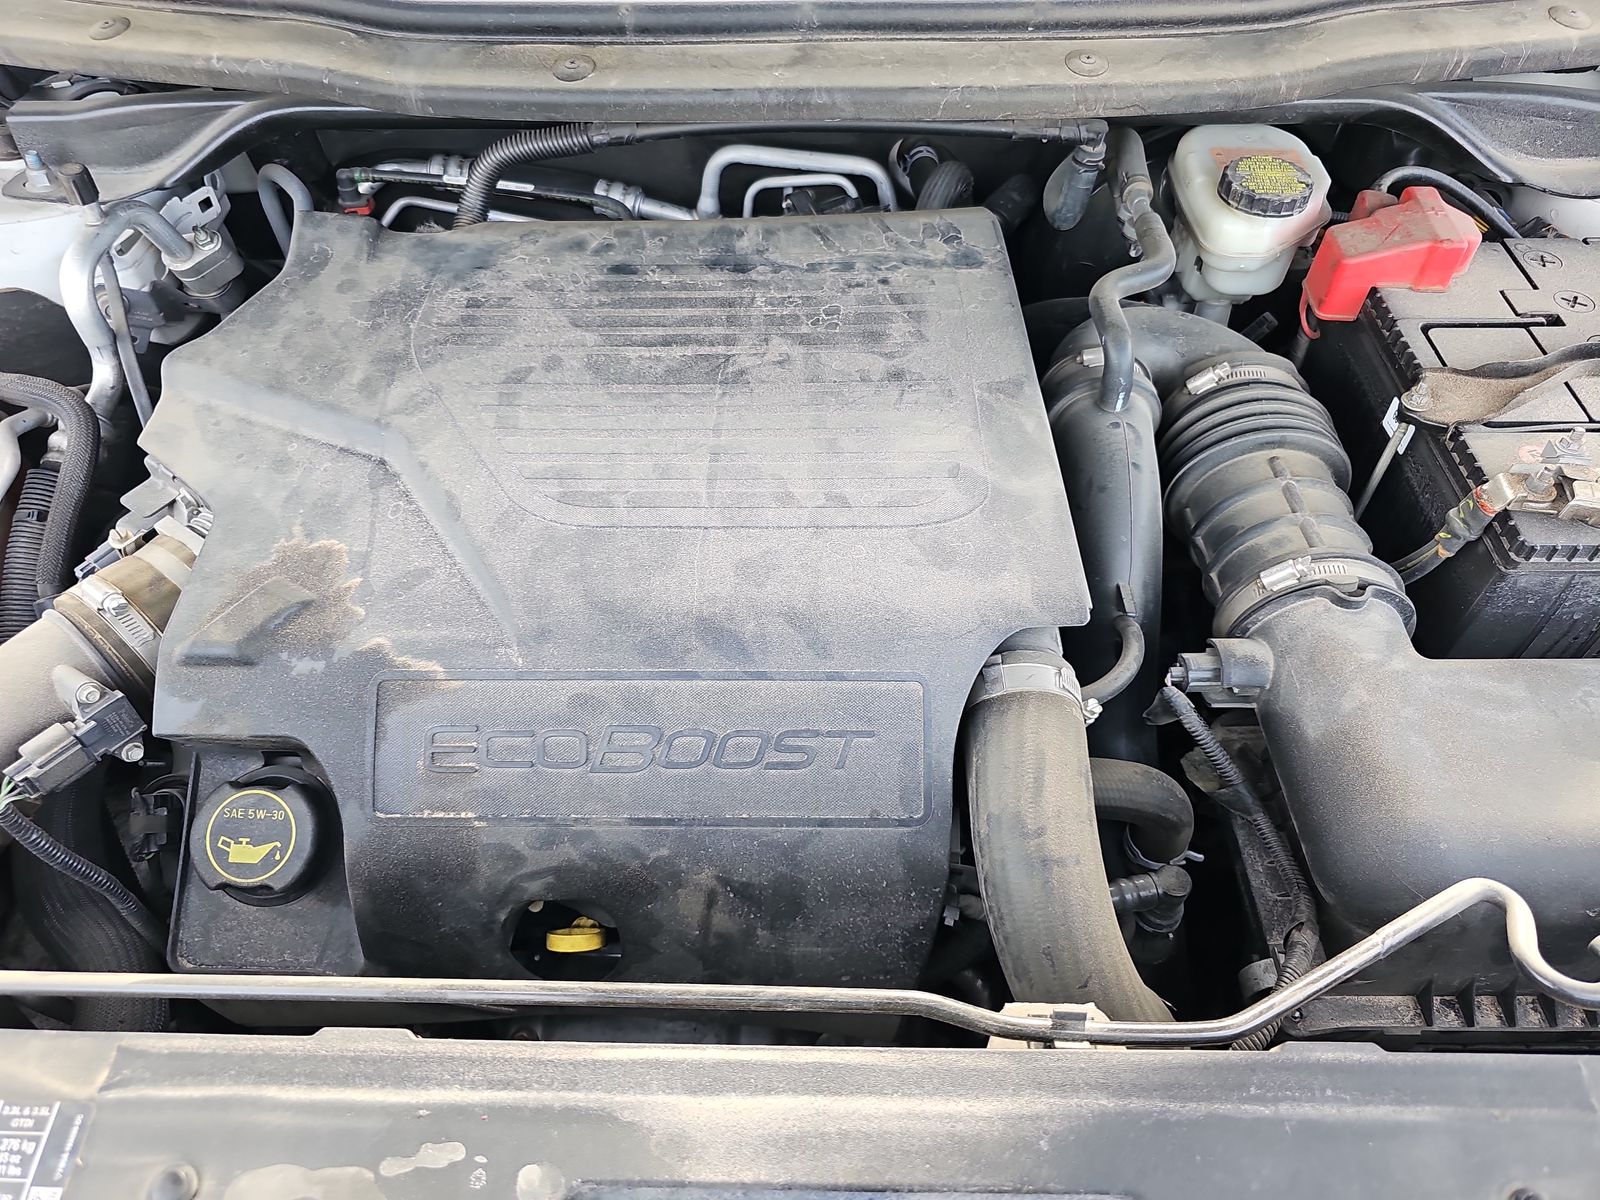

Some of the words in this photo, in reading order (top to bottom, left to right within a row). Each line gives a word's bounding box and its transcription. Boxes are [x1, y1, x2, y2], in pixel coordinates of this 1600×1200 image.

[223, 807, 245, 819] SAE
[247, 808, 285, 821] 5W-30
[21, 1139, 37, 1155] kg
